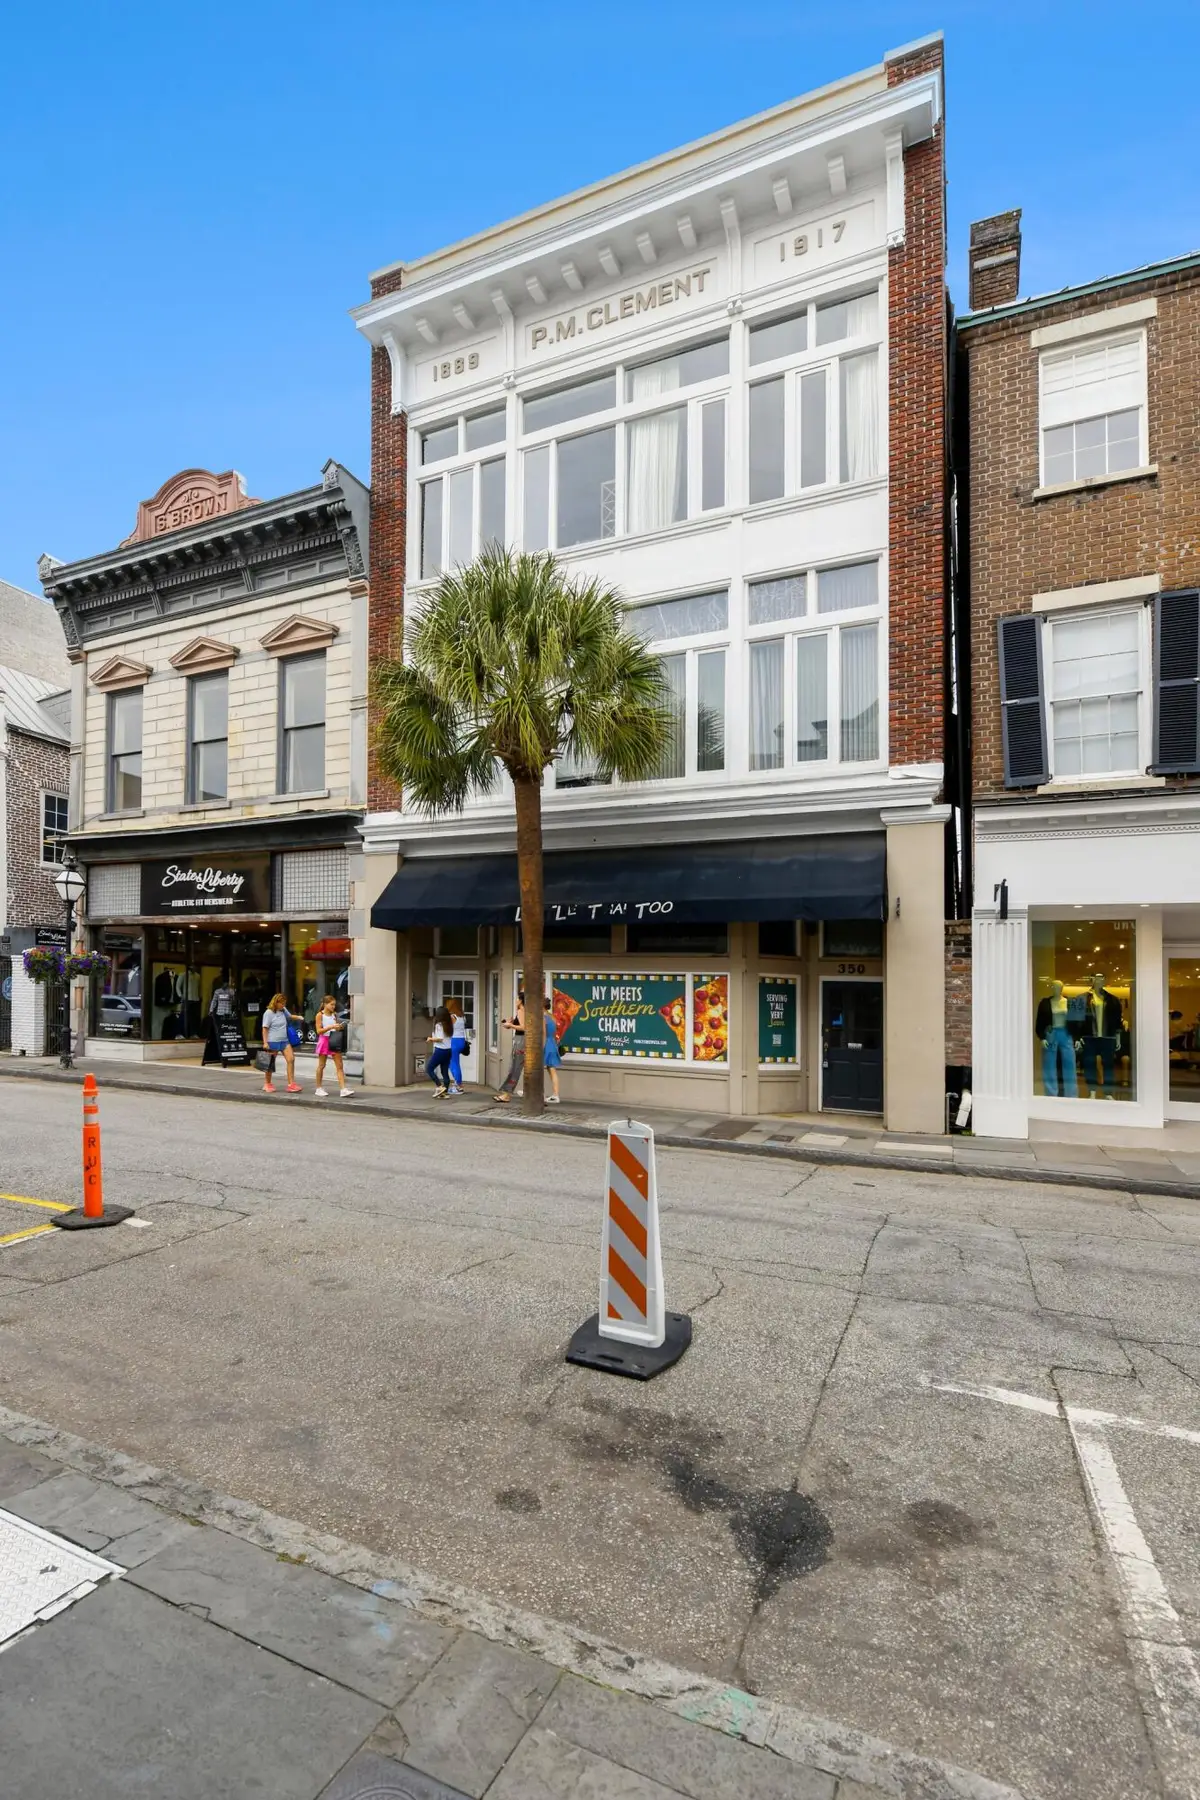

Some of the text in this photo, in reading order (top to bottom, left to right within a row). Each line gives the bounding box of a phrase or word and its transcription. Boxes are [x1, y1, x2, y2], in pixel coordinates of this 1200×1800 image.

[780, 219, 846, 263] 1917
[433, 352, 480, 382] 1889
[635, 901, 674, 919] TOO
[837, 963, 866, 975] 350
[592, 985, 643, 1002] NY MEETS
[766, 993, 788, 1003] SERVING
[579, 999, 657, 1022] Southern
[769, 1002, 785, 1011] Y'ALL
[770, 1011, 784, 1020] VERY
[598, 1017, 637, 1034] CHARM
